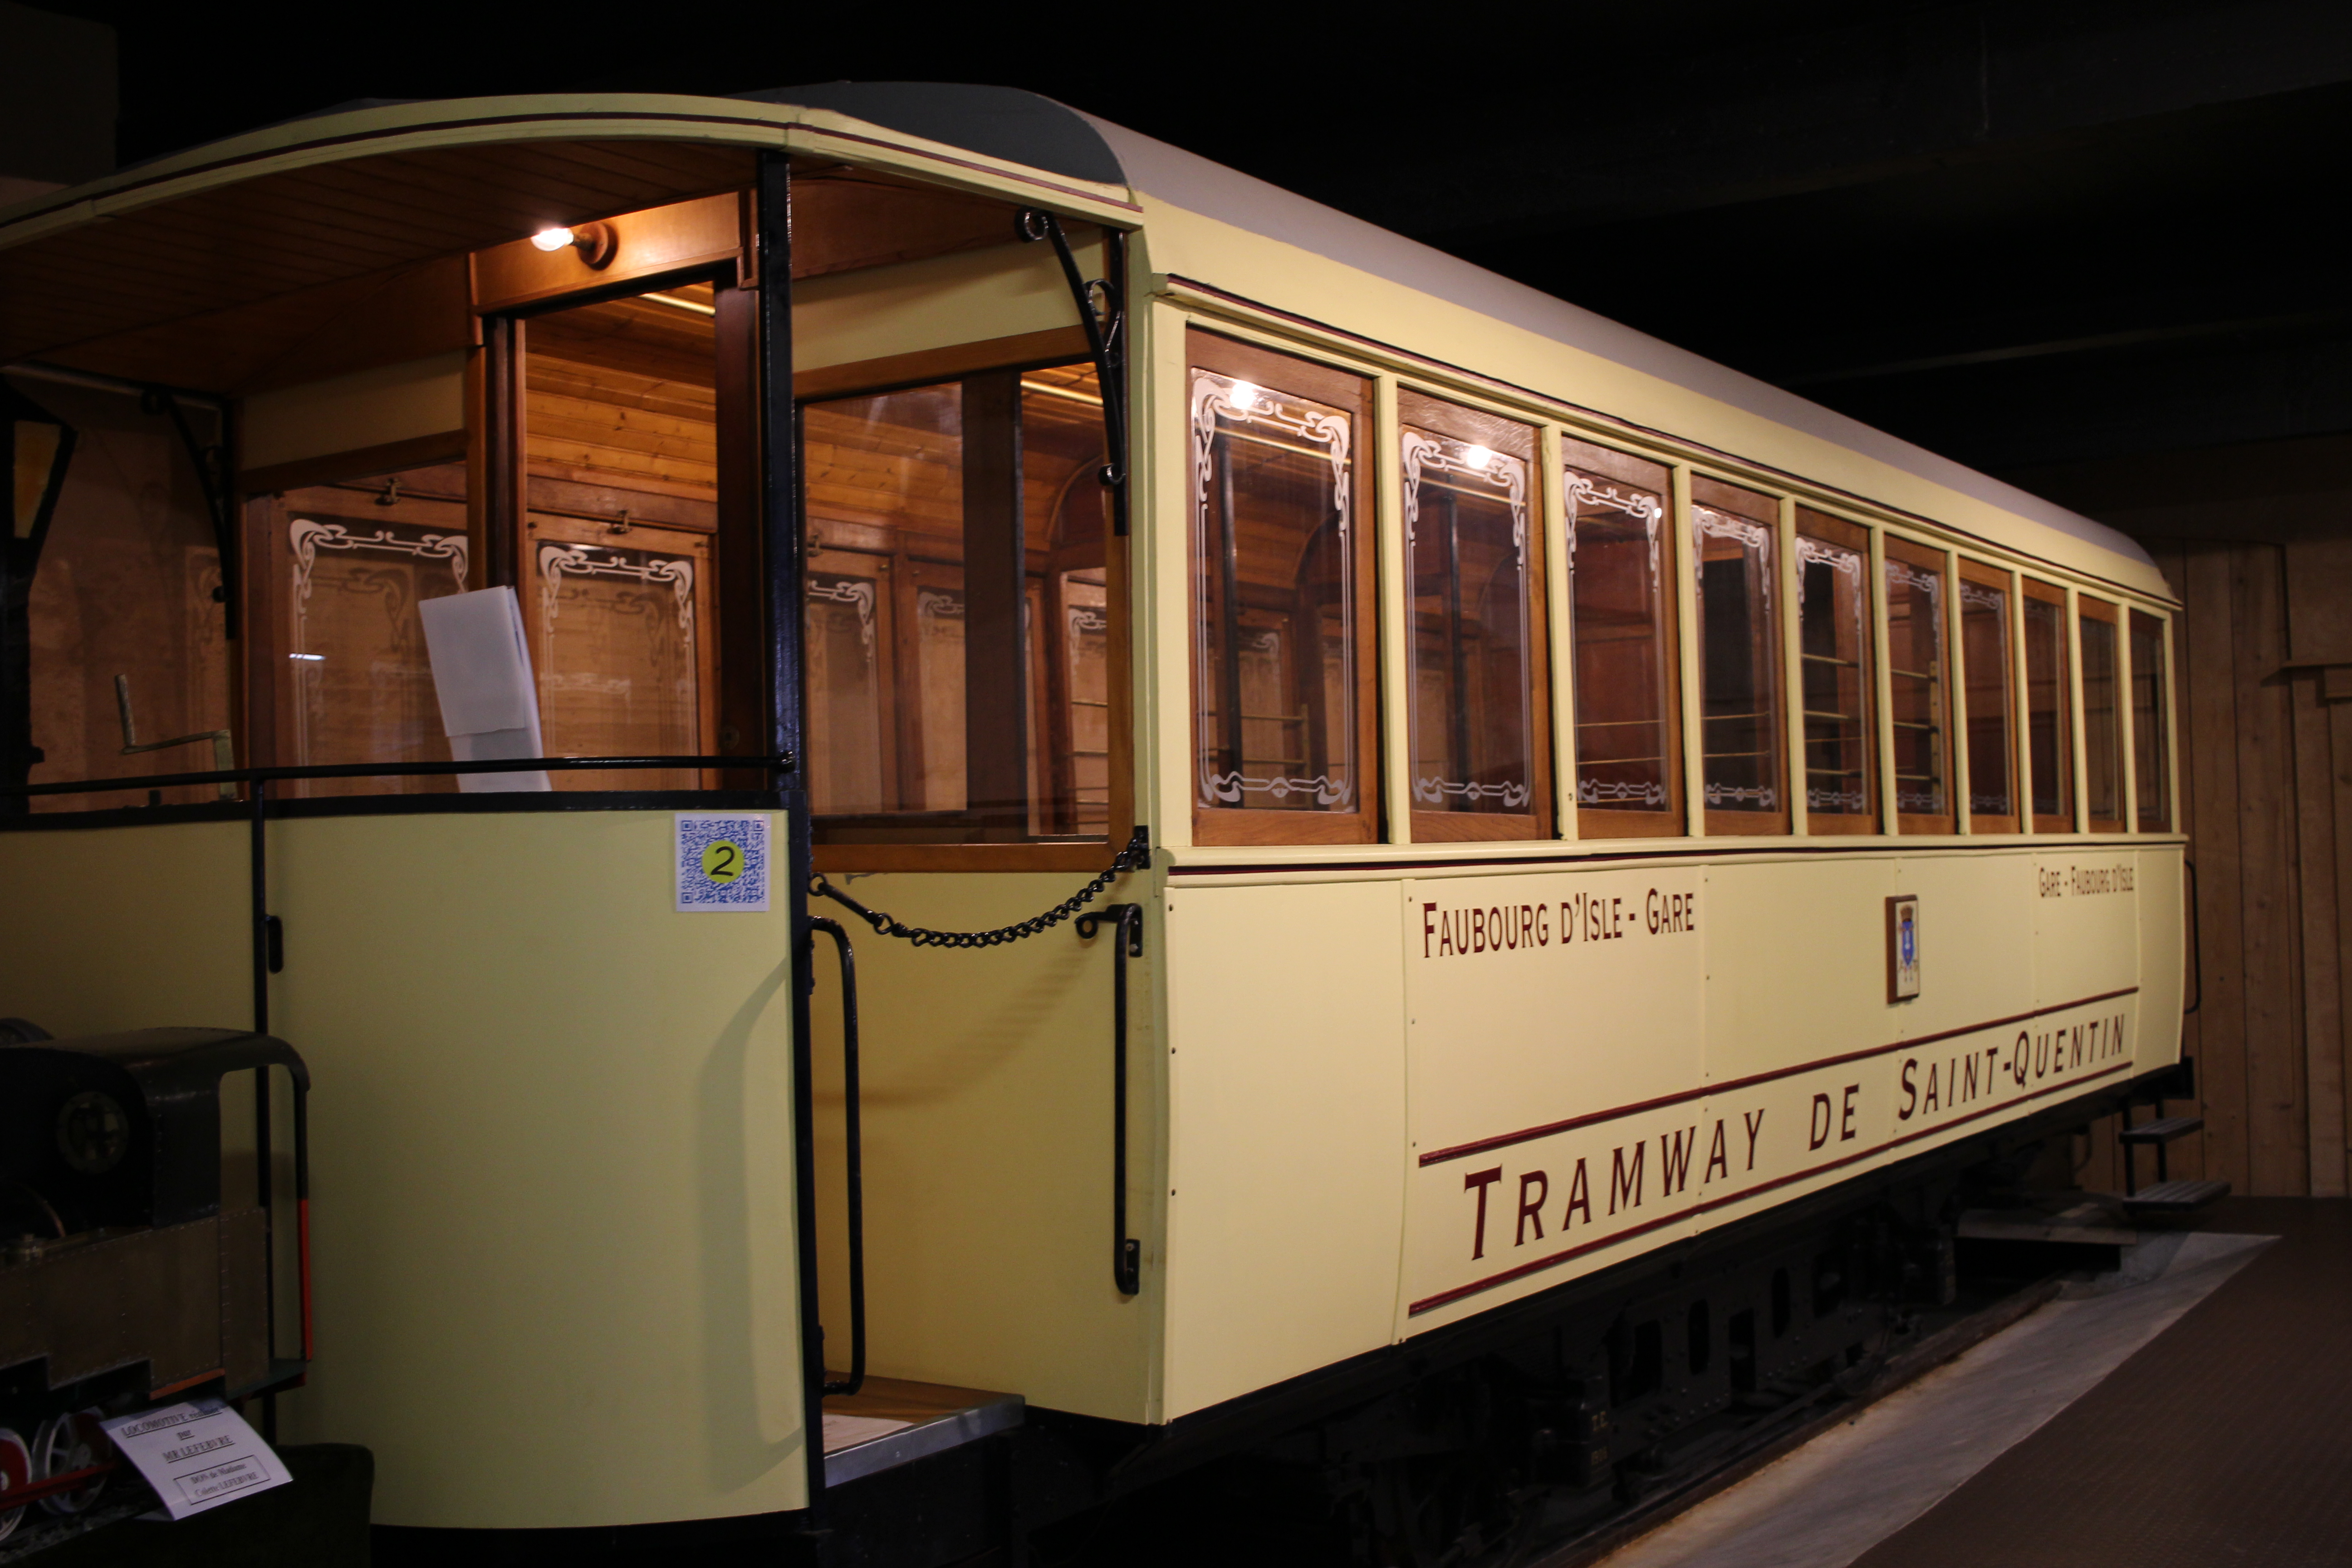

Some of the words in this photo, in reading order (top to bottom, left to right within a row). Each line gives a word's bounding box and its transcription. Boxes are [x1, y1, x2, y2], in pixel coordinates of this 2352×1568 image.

[710, 846, 735, 876] 2
[2039, 867, 2061, 897] GARE
[2071, 866, 2109, 896] FAUBOURG
[1422, 902, 1548, 958] FAUBOURG
[1646, 888, 1695, 935] GARE
[1465, 1108, 1765, 1261] TRAMWAY
[1809, 1083, 1859, 1151] DE
[1898, 1014, 2124, 1121] SAINT-QUENTIN
[121, 1413, 188, 1436] LOCOMOTIVE
[163, 1450, 181, 1460] MR
[181, 1434, 233, 1455] LEFEBVRE
[191, 1474, 209, 1484] DON
[219, 1472, 259, 1490] LEFEBVRE
